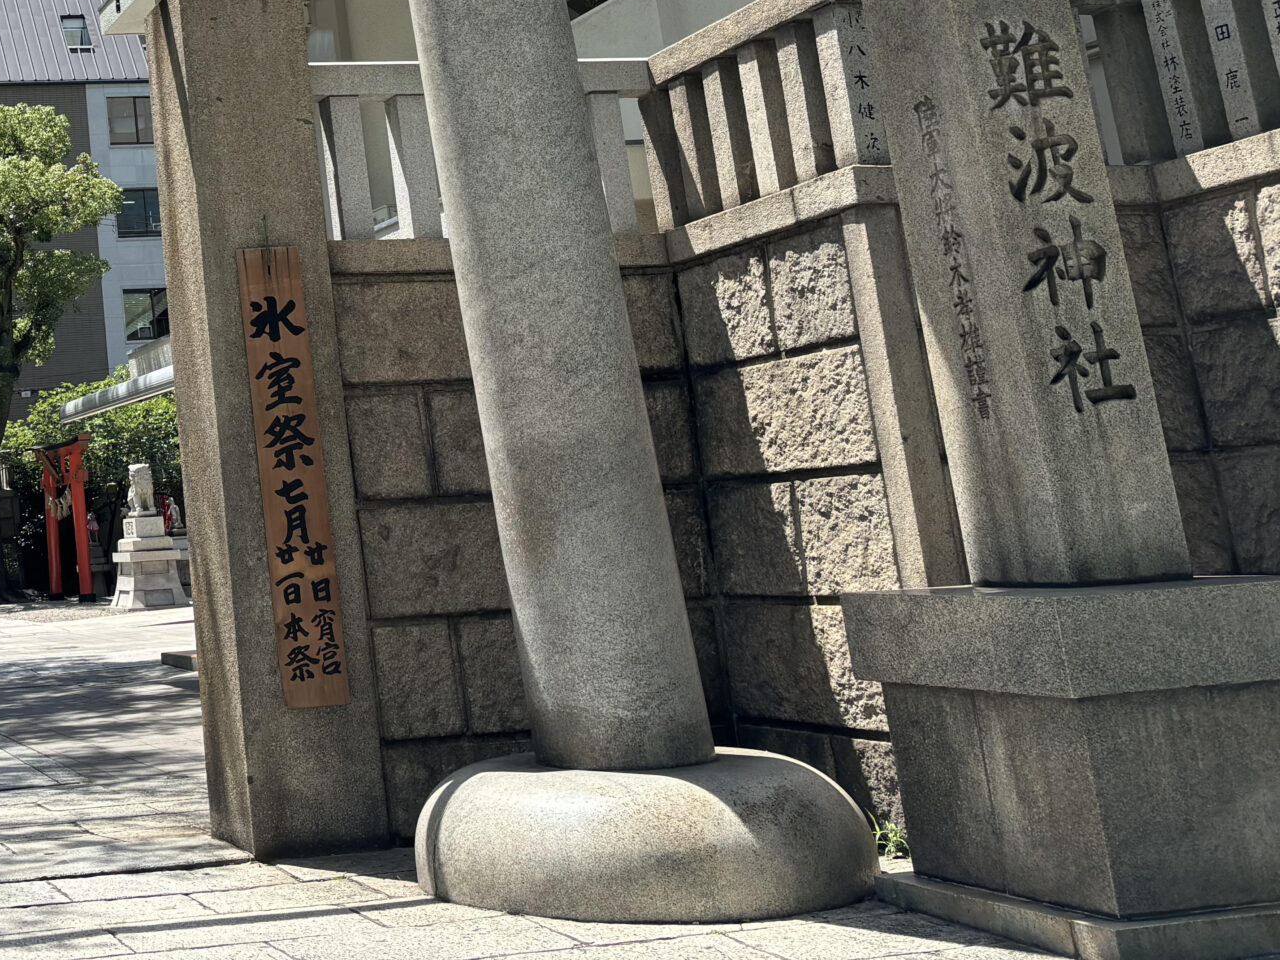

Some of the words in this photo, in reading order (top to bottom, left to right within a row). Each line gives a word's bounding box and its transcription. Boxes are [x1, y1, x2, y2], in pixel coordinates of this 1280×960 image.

[980, 19, 1136, 413] 難波神社
[249, 295, 316, 545] 氷室祭七月
